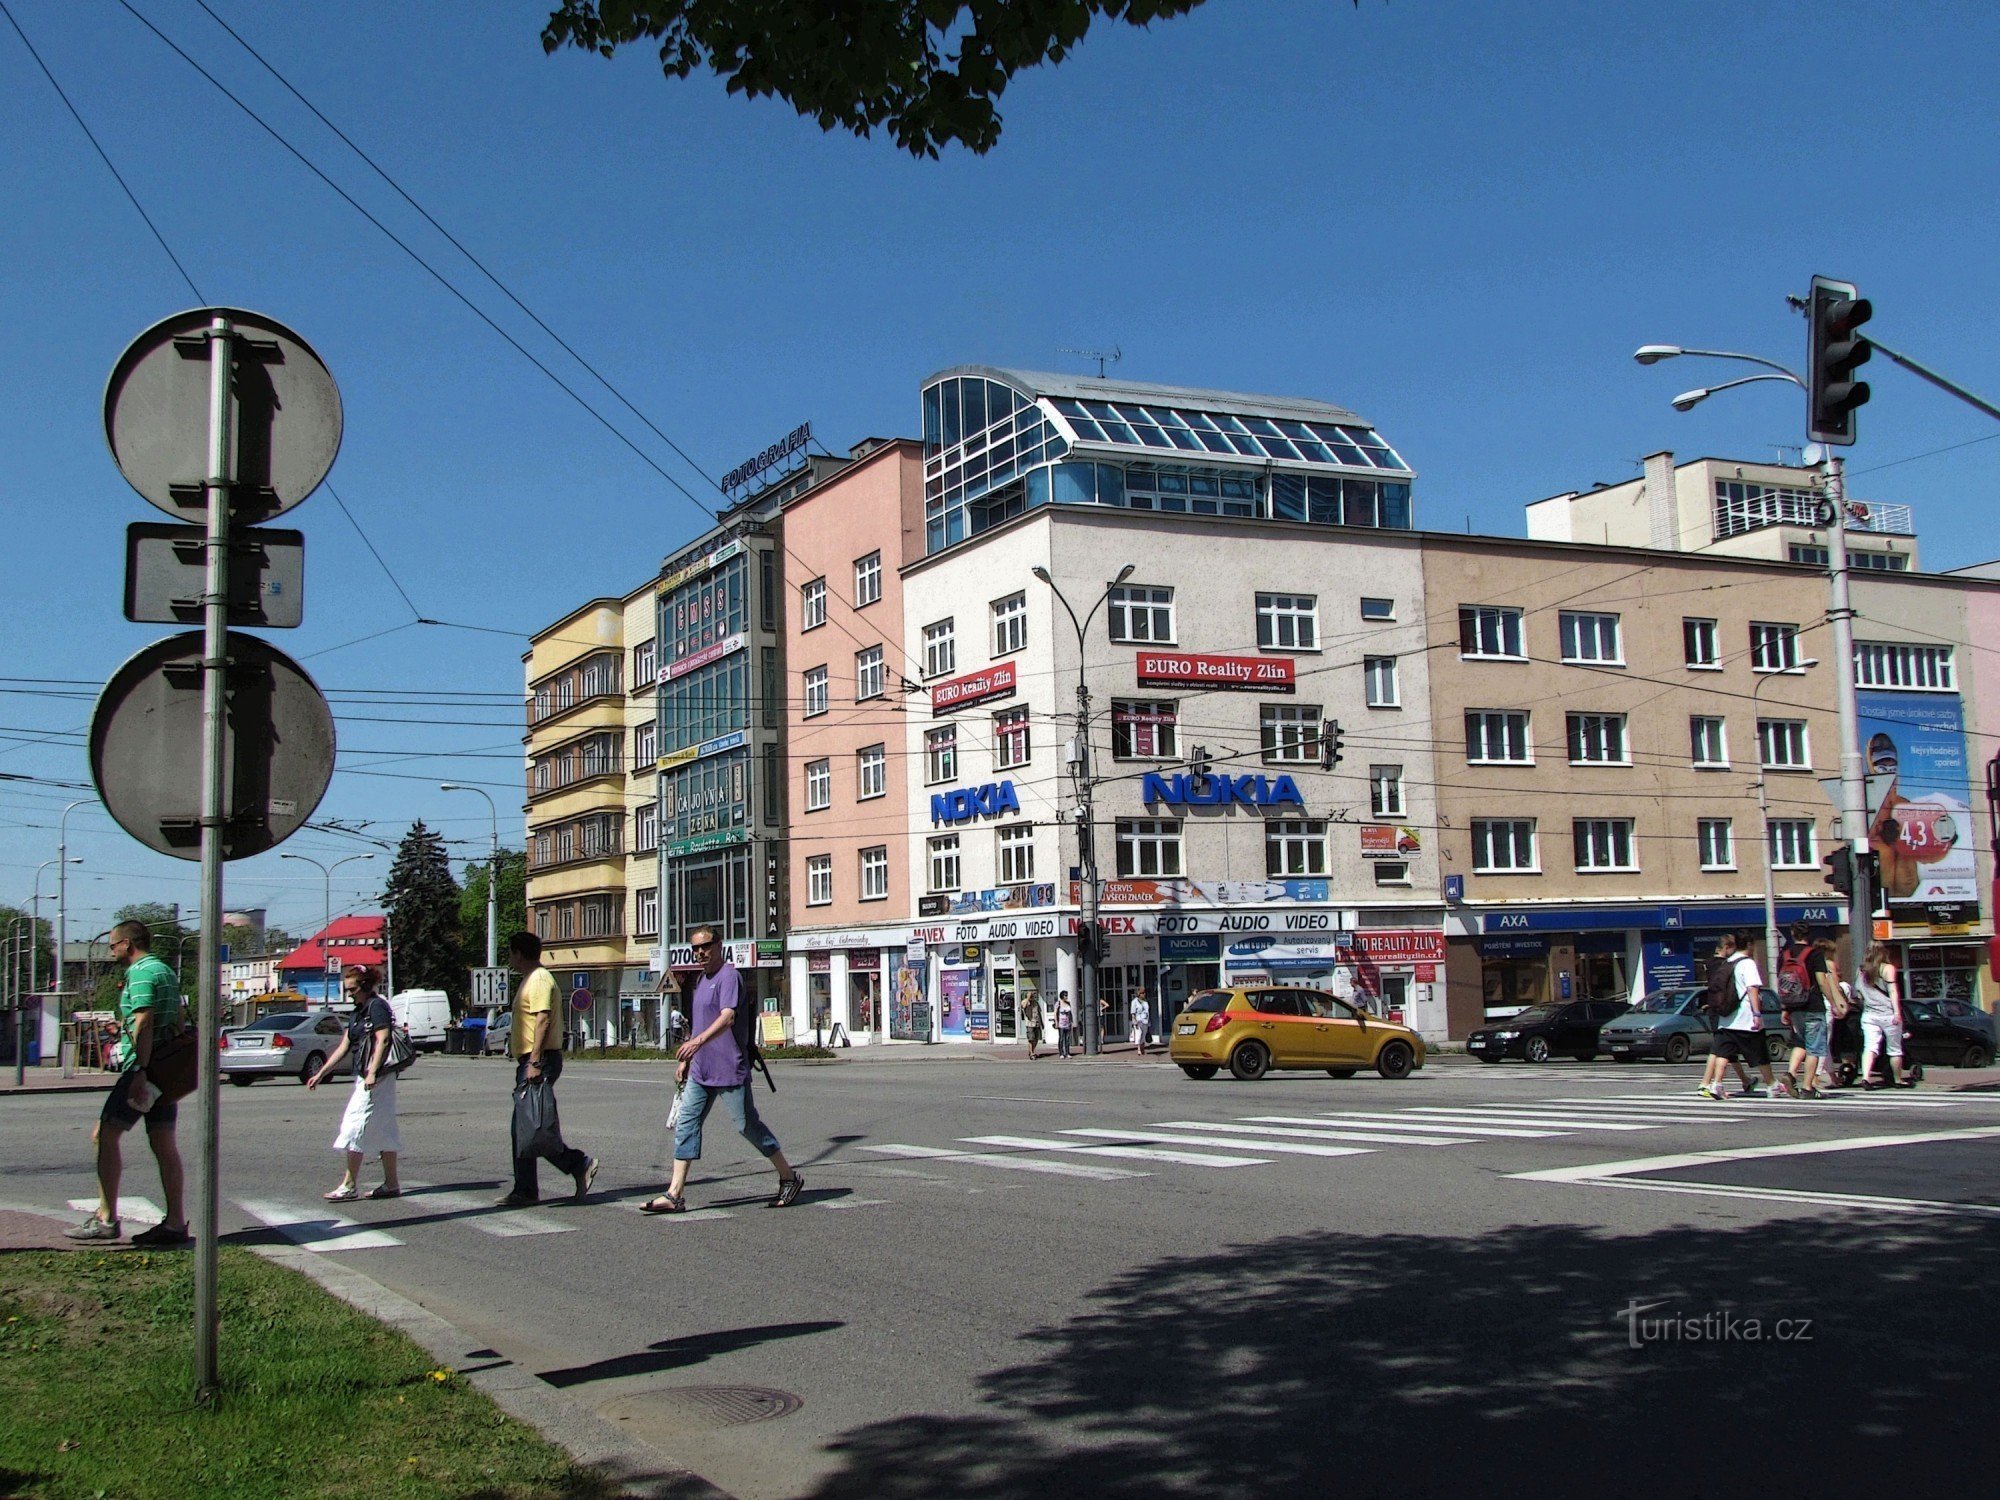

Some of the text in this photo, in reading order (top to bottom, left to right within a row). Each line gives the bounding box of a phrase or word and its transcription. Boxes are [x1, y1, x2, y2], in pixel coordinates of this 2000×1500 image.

[1145, 659, 1286, 681] EURO Reality Zlín
[936, 685, 960, 703] EURO
[994, 670, 1012, 687] Zlín
[1141, 715, 1162, 723] Reality
[1888, 707, 1905, 719] jsme
[1937, 709, 1956, 720] sazby
[1919, 723, 1929, 732] na
[1142, 773, 1305, 806] NOKIA
[931, 780, 1020, 823] NOKIA
[1109, 884, 1133, 892] SERVIS
[768, 859, 778, 932] HERNA
[1106, 892, 1127, 901] VŠECH
[1128, 891, 1154, 901] ZNAČEK
[1802, 908, 1827, 919] AXA
[1068, 915, 1329, 935] MVEX FOTO AUDIO VIDEO
[1500, 915, 1529, 927] AXA
[913, 920, 1054, 942] MAVEX FOTO AUDIO VIDEO
[1170, 939, 1208, 948] NOKIA
[1235, 942, 1271, 950] SAMSUNG
[1283, 936, 1330, 945] Autorizovaný
[1371, 937, 1411, 952] REALITY
[1414, 933, 1435, 950] ZLÍN
[1296, 946, 1319, 954] servis
